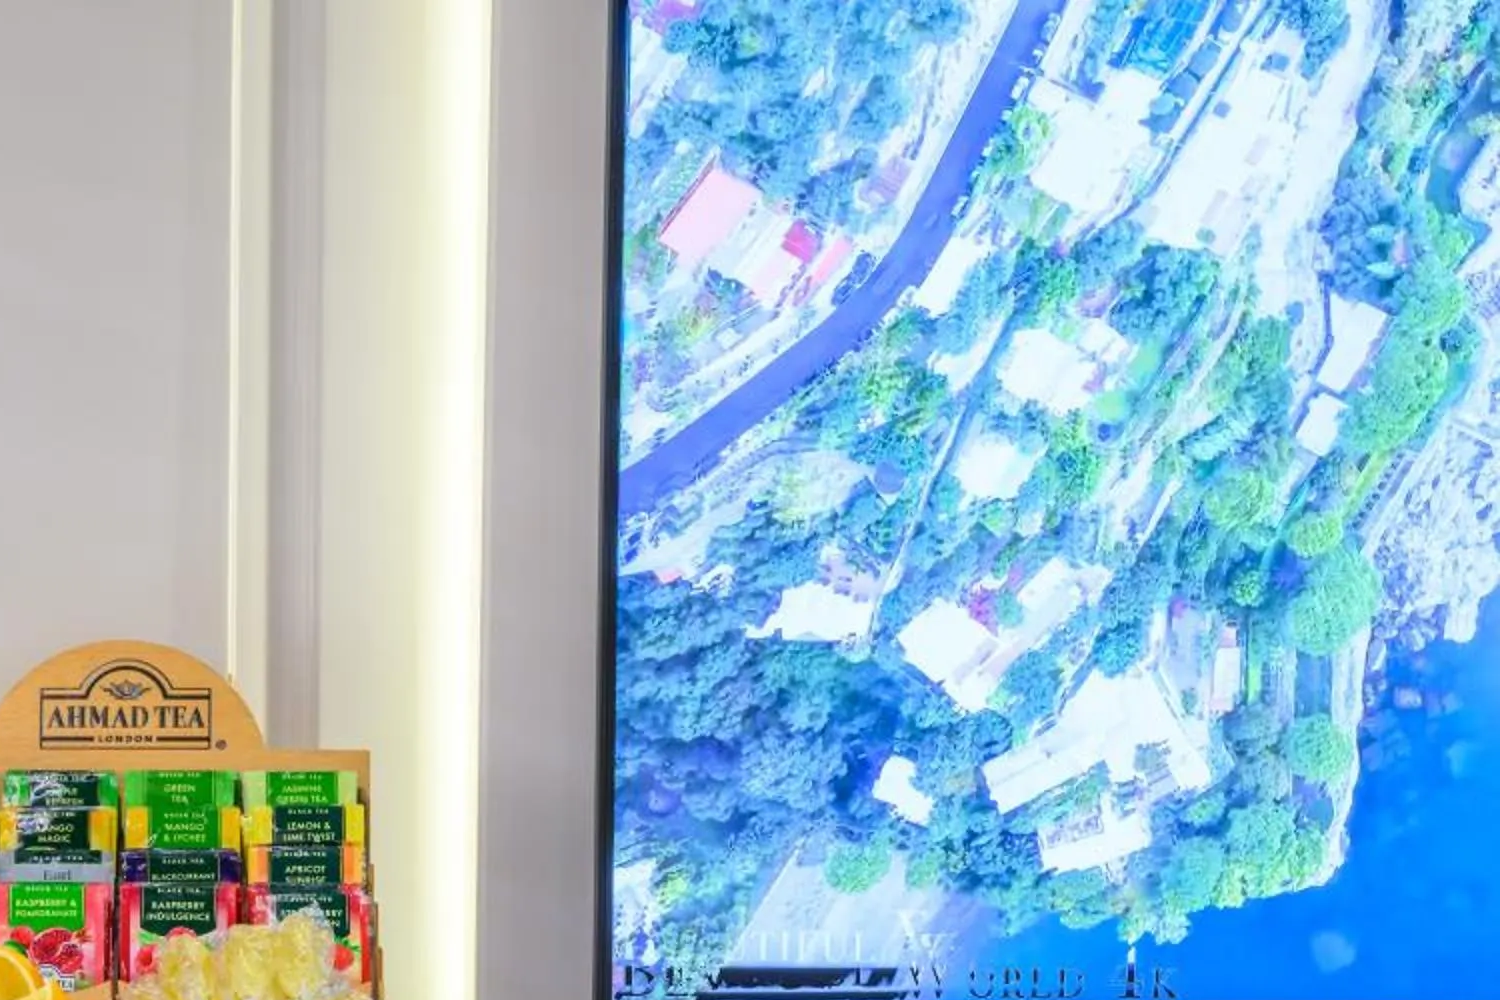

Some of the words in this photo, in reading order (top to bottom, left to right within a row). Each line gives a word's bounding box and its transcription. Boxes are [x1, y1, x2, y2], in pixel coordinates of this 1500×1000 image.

[48, 705, 148, 729] AHMAD
[153, 705, 204, 729] TEA
[98, 735, 153, 743] LONDON
[164, 784, 196, 793] GREEN
[171, 794, 189, 804] TEA
[311, 795, 329, 804] TEA
[165, 823, 205, 832] MANGO
[287, 821, 321, 831] LEMON
[323, 821, 332, 831] &
[283, 832, 304, 842] LIME
[307, 832, 336, 843] TWIST
[285, 865, 327, 874] APRICOT
[151, 873, 215, 881] BLACKCURRANT
[15, 899, 67, 907] RASPBERRY
[151, 901, 206, 910] RASPBERRY
[146, 911, 211, 921] INDULGENCE
